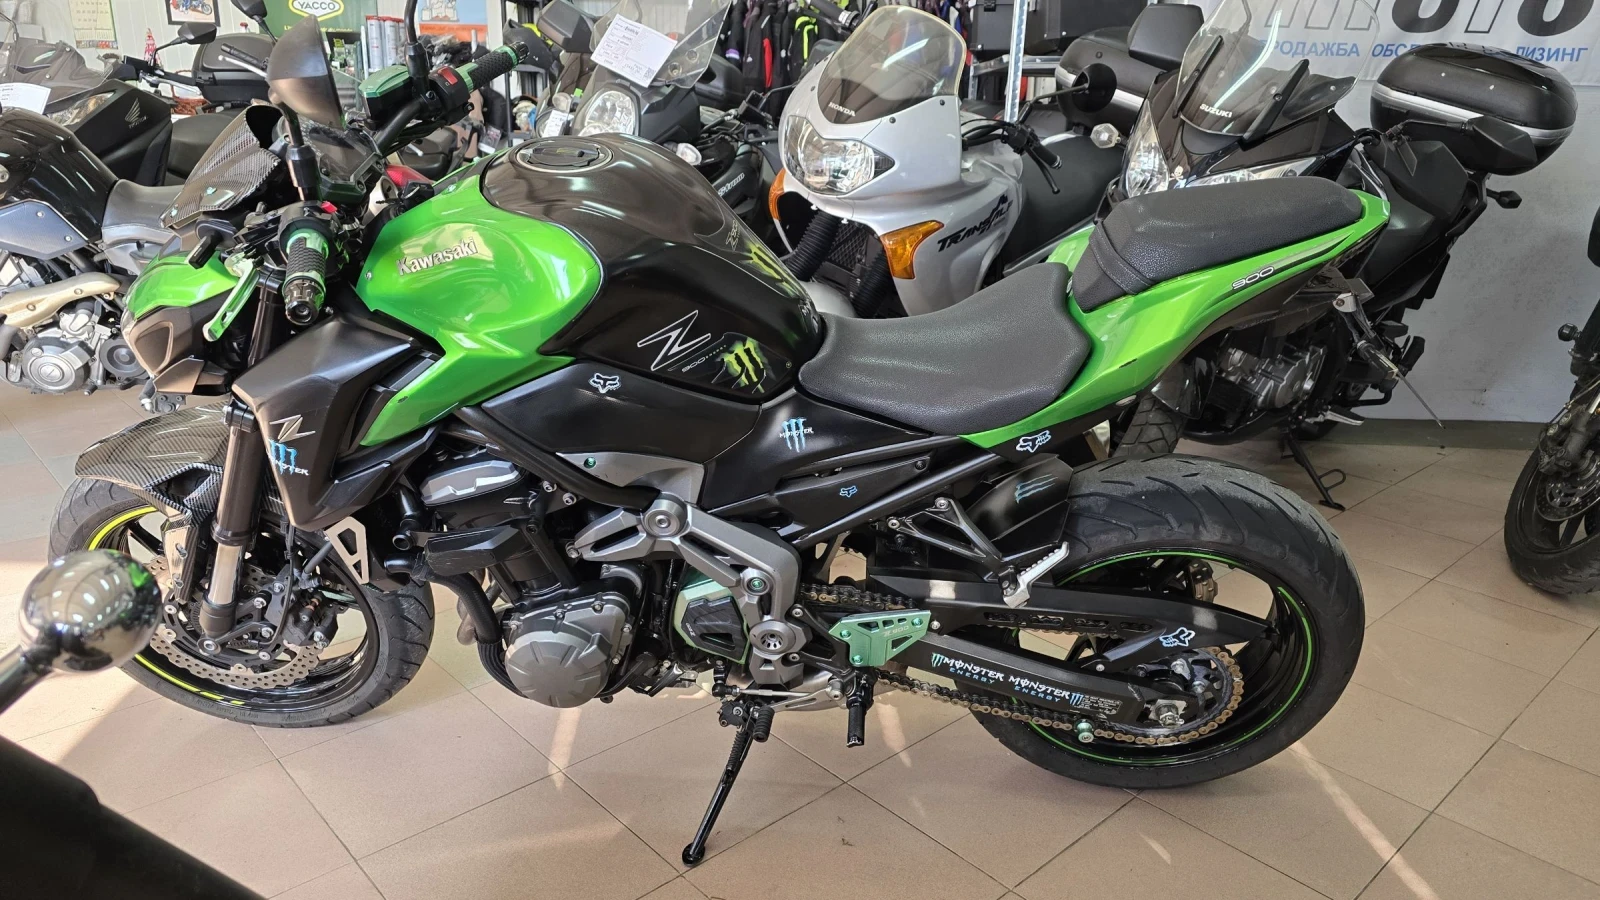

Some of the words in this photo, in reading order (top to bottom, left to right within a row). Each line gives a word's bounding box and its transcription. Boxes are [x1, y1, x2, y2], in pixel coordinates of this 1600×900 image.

[297, 1, 336, 10] YACCO
[828, 101, 856, 117] HONDA
[1199, 103, 1233, 118] SUZUKI
[396, 237, 478, 276] Kawasaki
[1232, 266, 1274, 290] 900
[943, 656, 1005, 682] MONSTER
[1008, 675, 1071, 700] MONSTER
[949, 667, 995, 684] ENERGY
[1014, 685, 1061, 702] ENERGY
